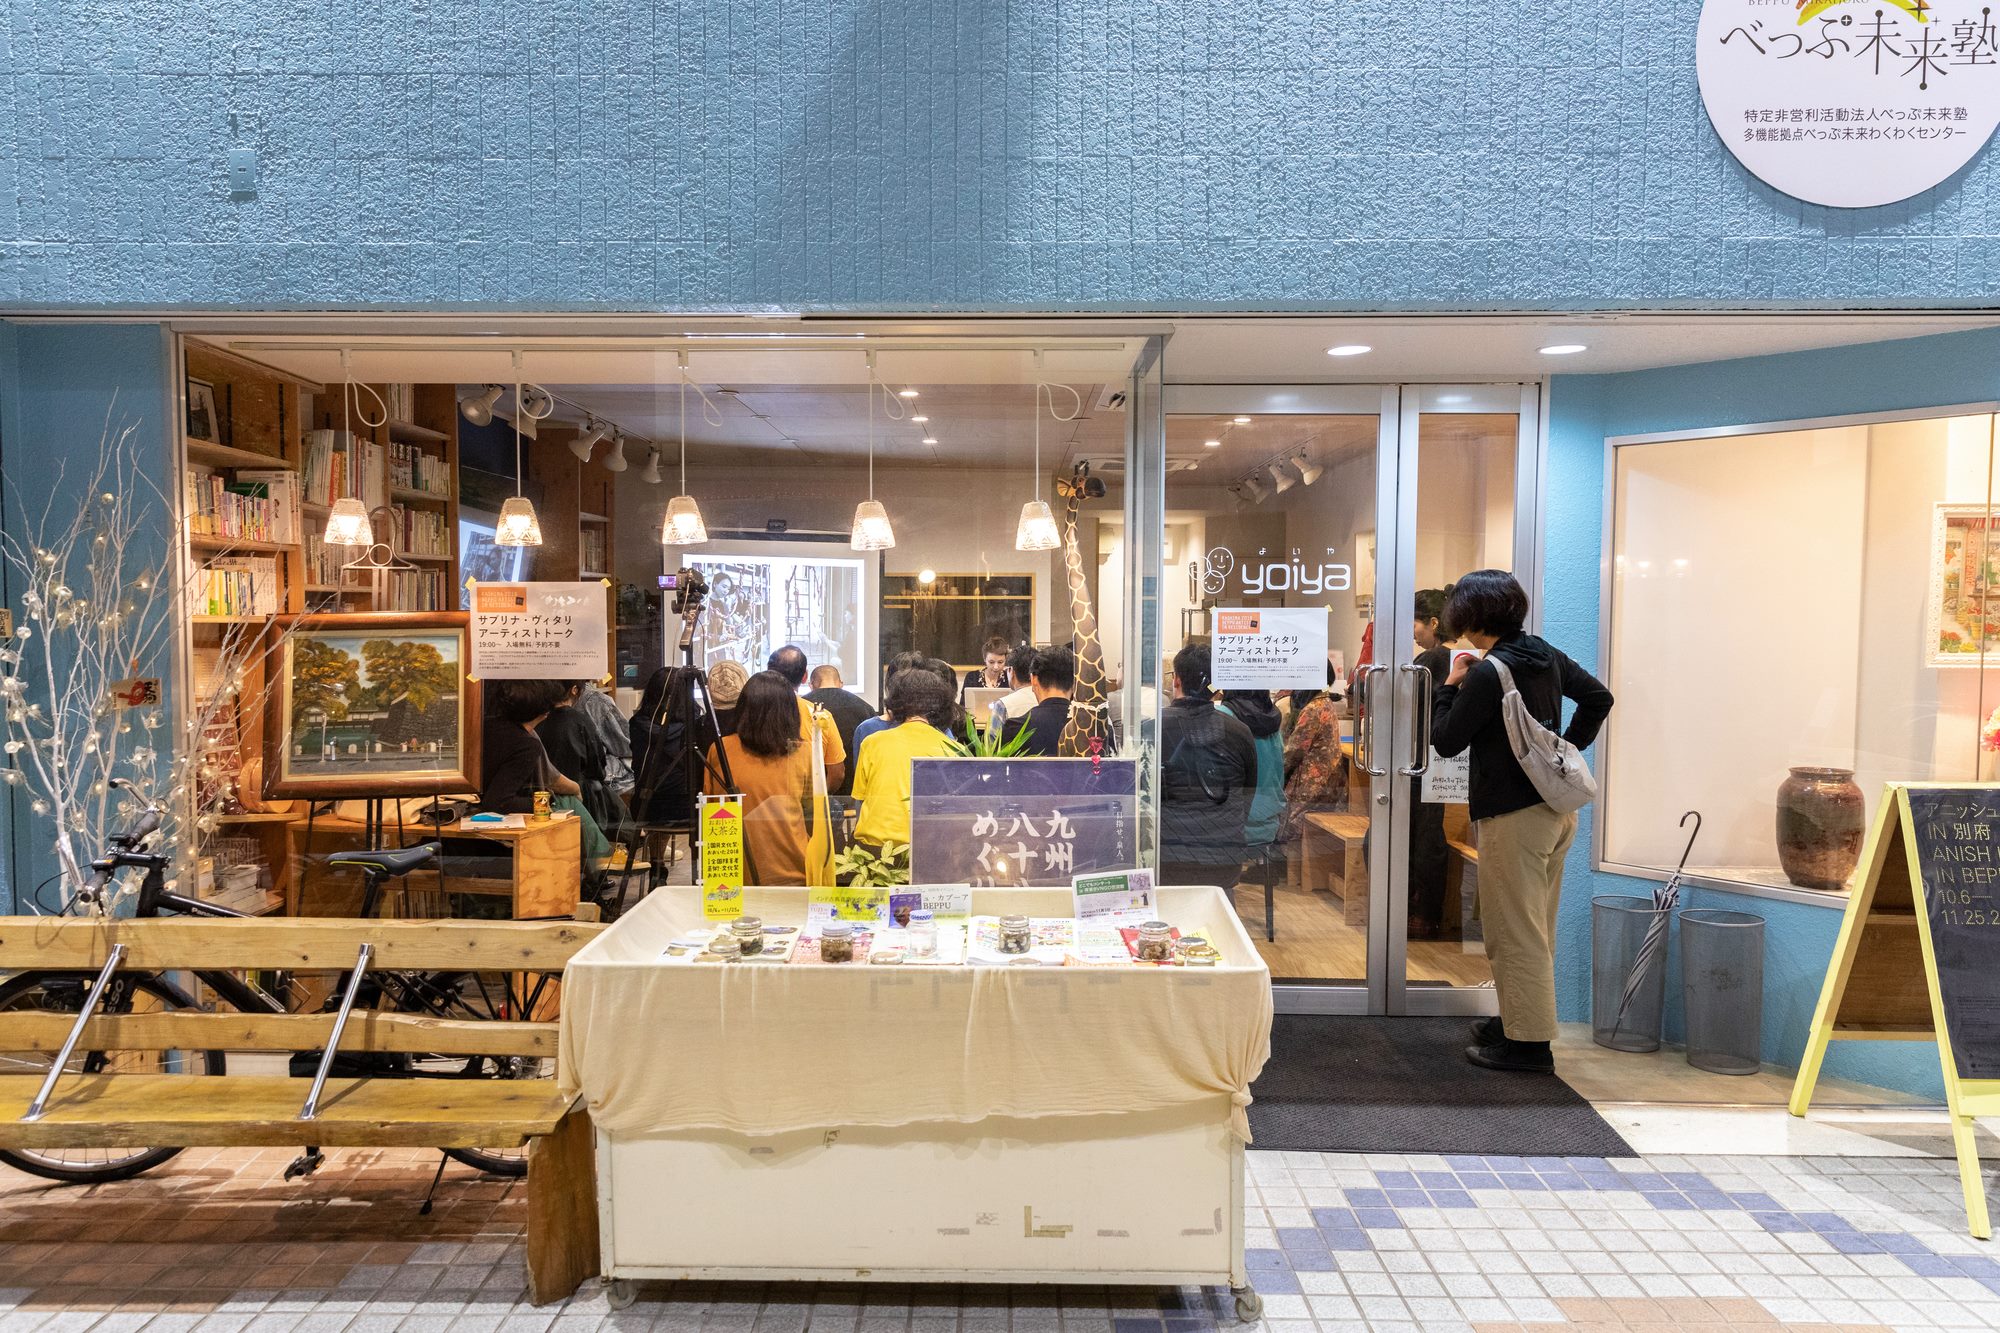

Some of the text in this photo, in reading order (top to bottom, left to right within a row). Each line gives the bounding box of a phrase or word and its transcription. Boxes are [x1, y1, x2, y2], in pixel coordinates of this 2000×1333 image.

[1719, 7, 2000, 90] べっぷ未来塾
[1744, 107, 1968, 123] 特定非営利活動法人べっぷ未来塾
[1743, 126, 1967, 142] 多機能拠点べっぷ未来わくわくセンター
[1241, 558, 1351, 595] yoiya
[478, 615, 572, 625] サブリナ・ヴィタリ
[478, 628, 574, 639] アーティストトーク
[1218, 635, 1299, 645] サブリナ・ヴィタリ
[1218, 646, 1300, 656] アーティストトーク
[1928, 822, 1991, 841] IN 別府
[1045, 809, 1076, 873] 九州
[1933, 845, 1991, 862] ANISH
[1936, 867, 2000, 884] IN BEP
